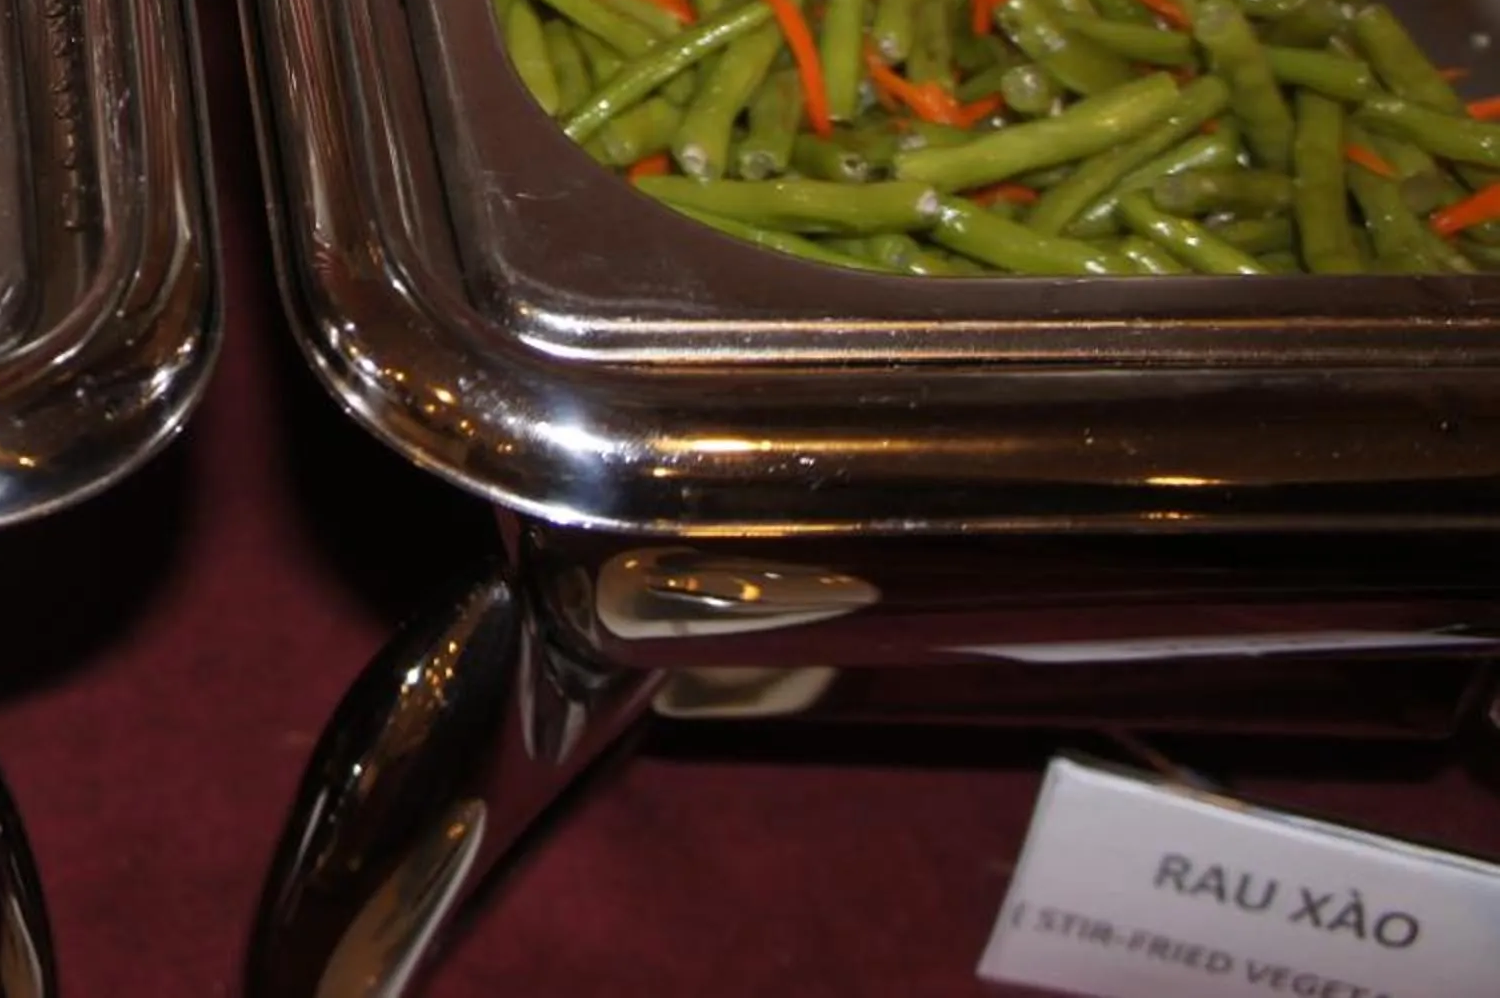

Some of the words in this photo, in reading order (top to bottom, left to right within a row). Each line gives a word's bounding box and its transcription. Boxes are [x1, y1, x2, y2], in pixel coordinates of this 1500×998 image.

[1034, 904, 1233, 976] STIR-FRIED
[1152, 852, 1279, 914] RAU
[1288, 887, 1420, 950] XÀO
